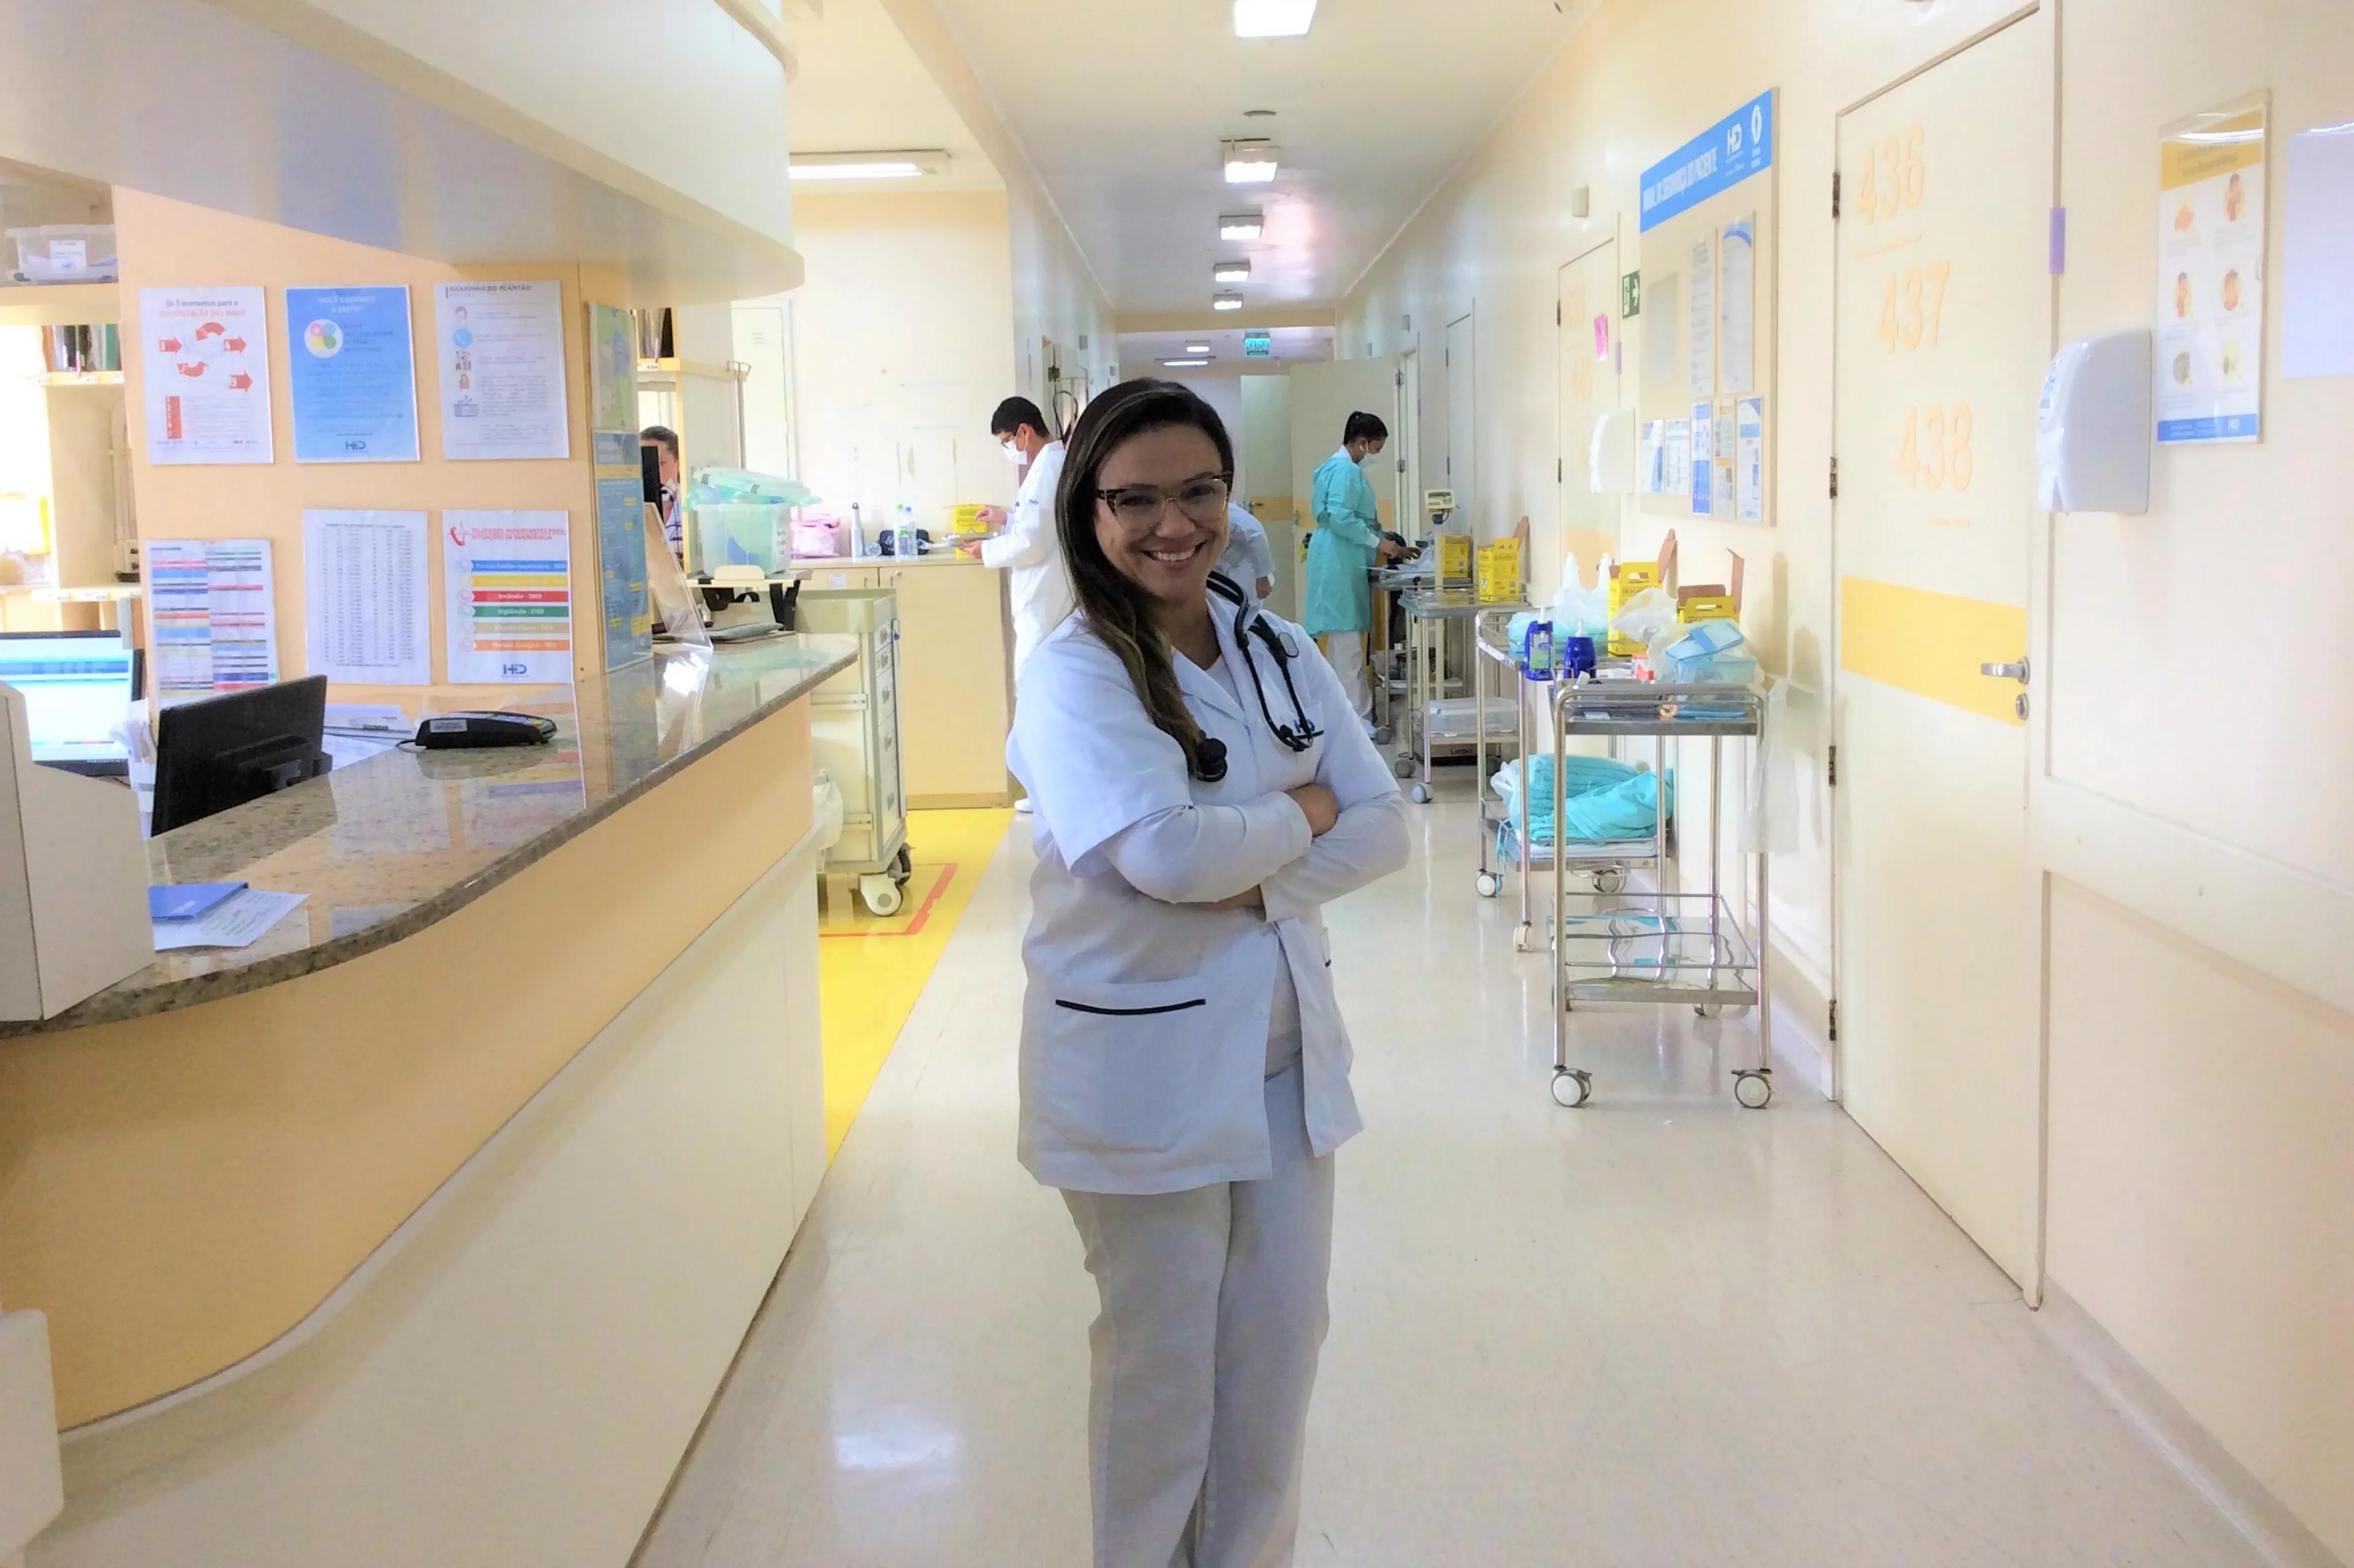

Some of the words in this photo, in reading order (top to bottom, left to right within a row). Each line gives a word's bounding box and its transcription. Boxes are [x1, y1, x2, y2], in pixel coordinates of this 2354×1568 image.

[1856, 124, 1925, 225] 436
[1876, 259, 1950, 354] 437
[1898, 402, 1973, 492] 438
